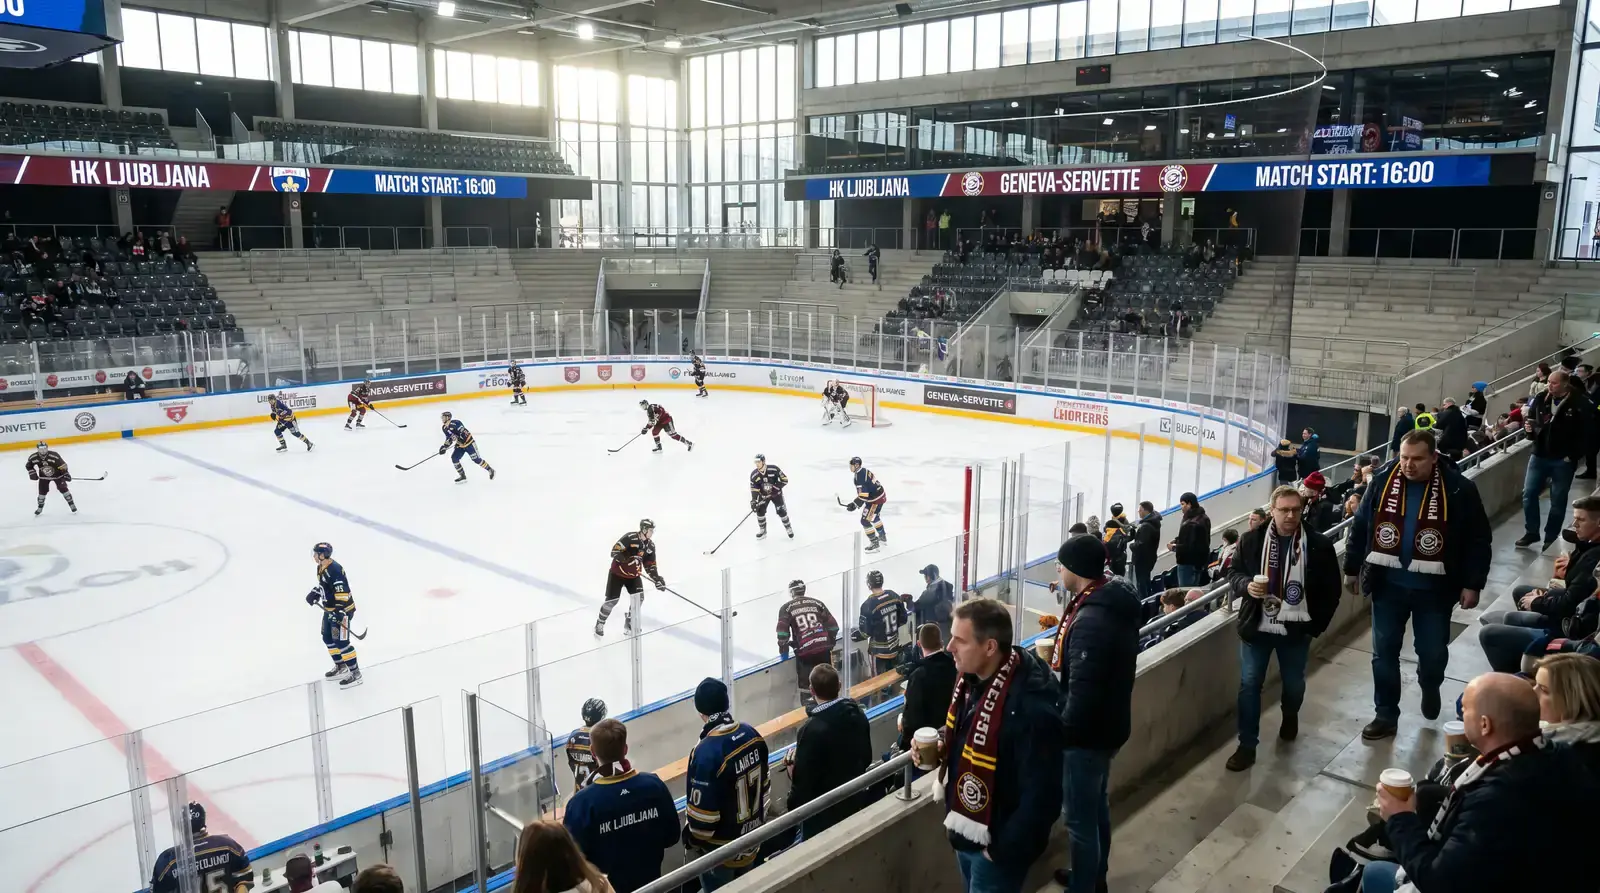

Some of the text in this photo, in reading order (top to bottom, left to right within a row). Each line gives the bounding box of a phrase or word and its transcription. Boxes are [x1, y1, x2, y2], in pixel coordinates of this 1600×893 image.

[70, 160, 211, 188] HK LJUBLJANA
[375, 174, 496, 195] MATCH START: 16:00
[1000, 168, 1141, 194] GENEVA-SERVETTE
[1255, 160, 1434, 187] MATCH START: 16:00
[829, 177, 910, 198] HK LJUBLJANA
[926, 390, 1004, 408] GENEVA-SERVETTE
[735, 763, 762, 824] 17
[599, 807, 659, 835] HK LJUBLJANA
